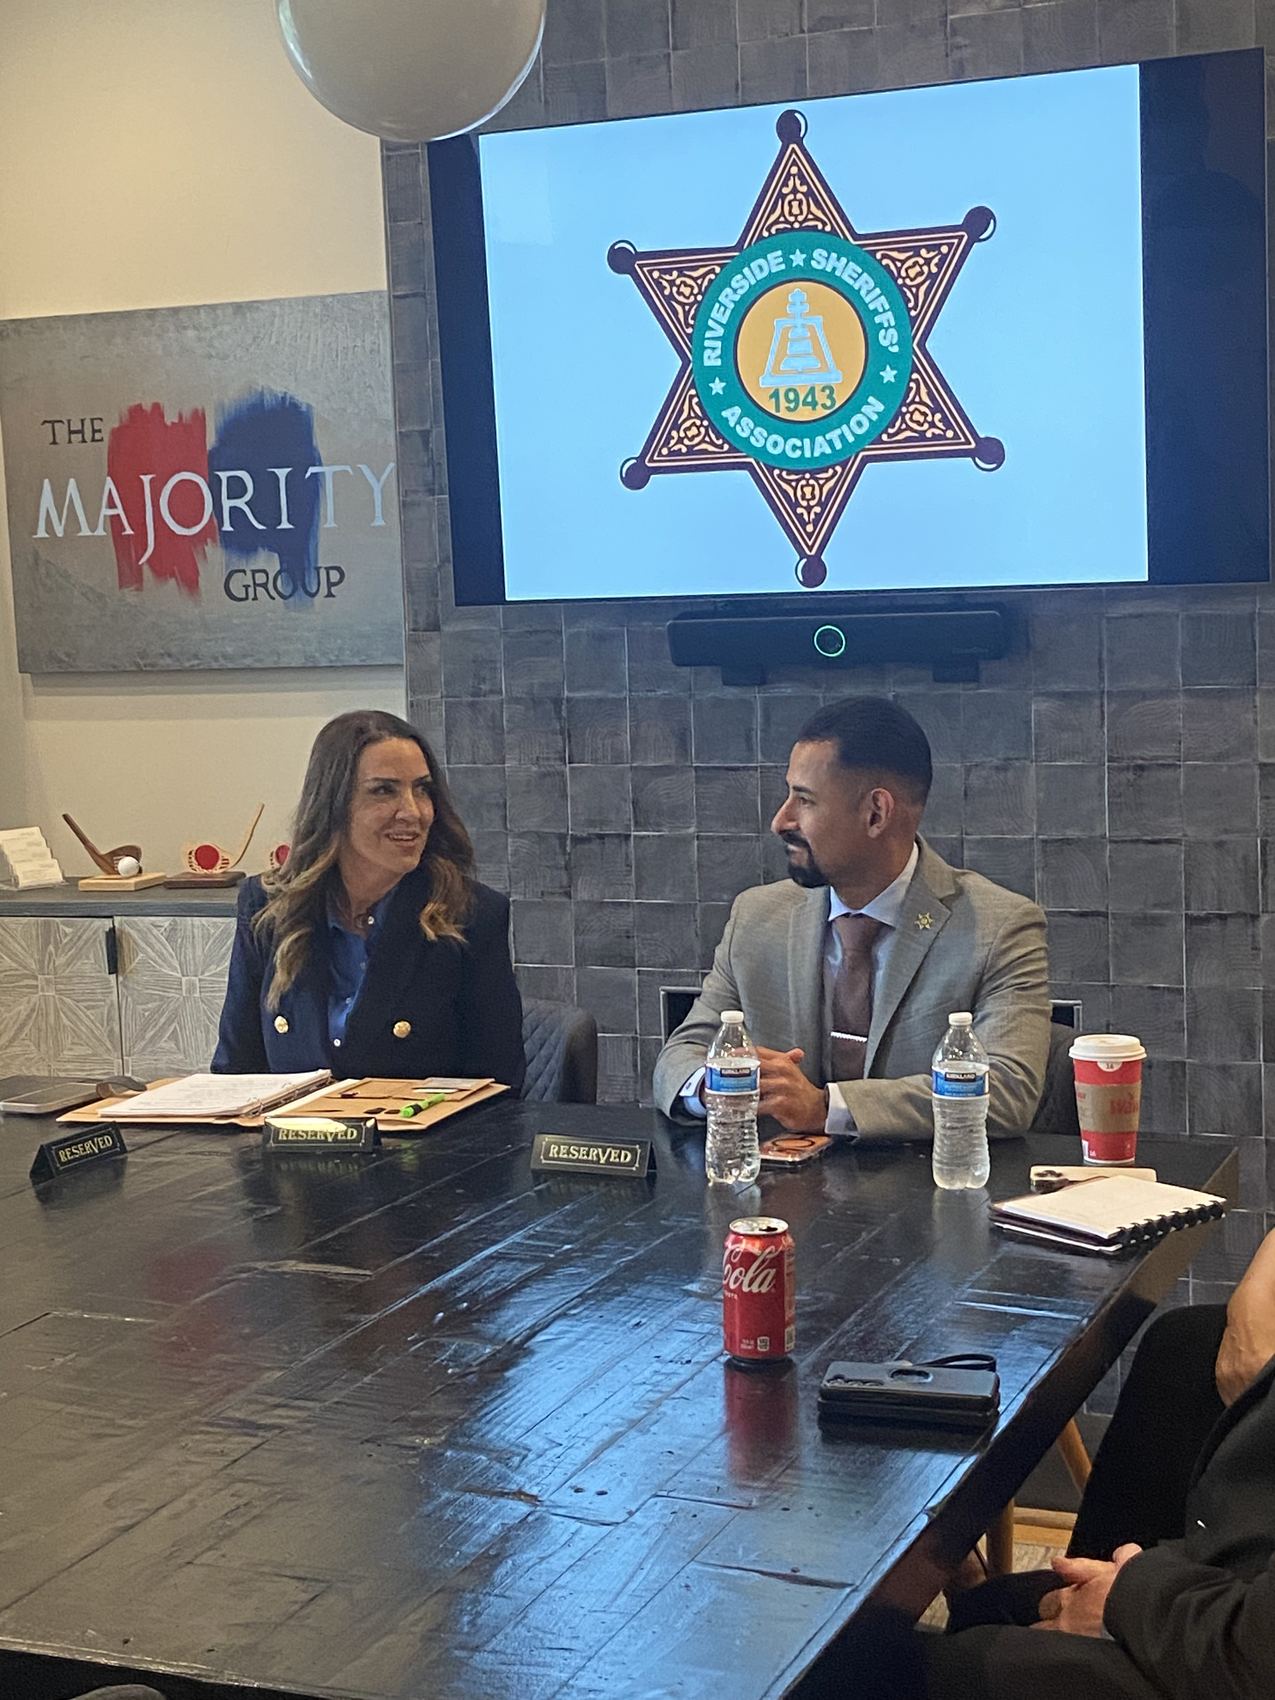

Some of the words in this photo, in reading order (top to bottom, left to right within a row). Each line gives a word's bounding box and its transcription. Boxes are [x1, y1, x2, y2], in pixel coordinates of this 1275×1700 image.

[703, 250, 786, 367] RIVERSIDE
[810, 248, 900, 353] SHERIFFS'
[768, 384, 837, 413] 1943
[41, 416, 105, 445] THE
[721, 395, 886, 458] ASSOCIATION
[32, 462, 396, 565] MAJORITY
[223, 565, 346, 602] GROUP
[58, 1135, 113, 1162] RESERVED
[278, 1127, 358, 1142] RESERVED
[549, 1144, 632, 1164] RESERVED
[722, 1240, 783, 1293] Cola
